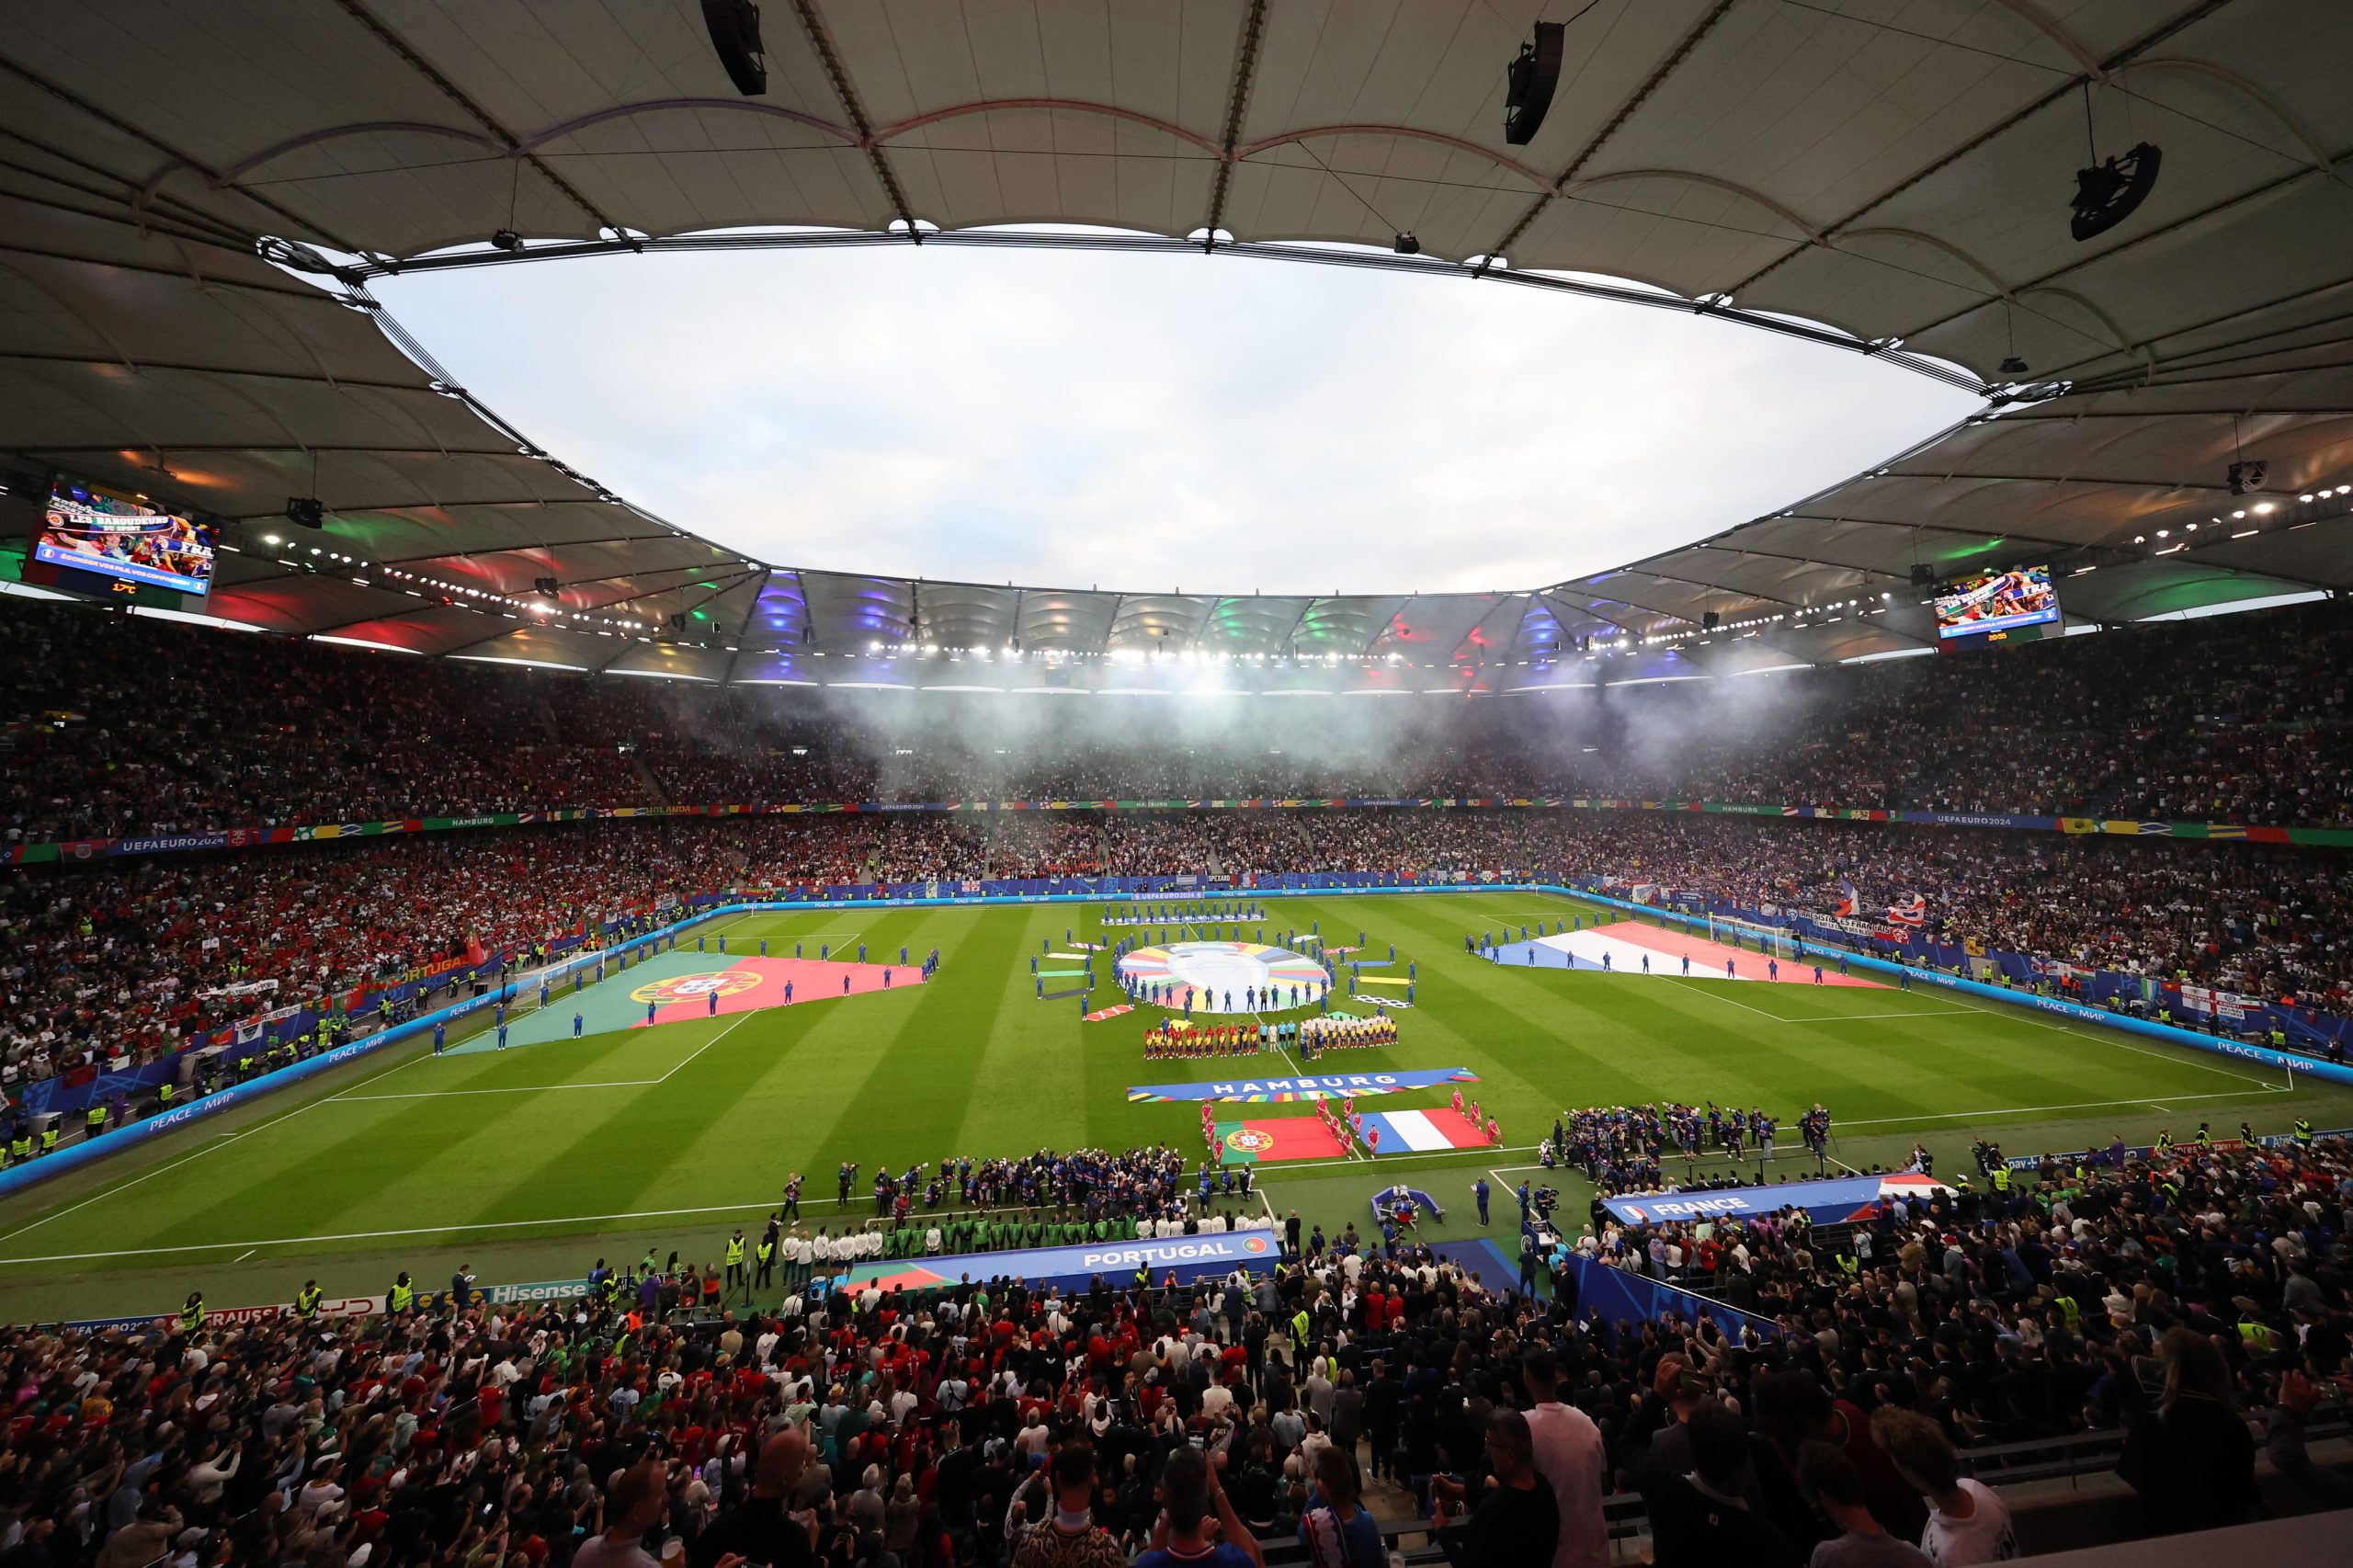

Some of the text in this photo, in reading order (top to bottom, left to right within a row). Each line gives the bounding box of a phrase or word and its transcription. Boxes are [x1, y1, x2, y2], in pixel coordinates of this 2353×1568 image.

[69, 515, 169, 526] LES BAROUDEURS
[1722, 805, 1758, 813] HAMBURG
[452, 817, 494, 826] HAMBURG
[1208, 874, 1231, 882] SPEXARD
[1806, 946, 1824, 956] PEACE
[1937, 976, 1956, 986] МИР
[449, 1002, 471, 1017] PEACE
[2036, 999, 2069, 1014] PEACE
[2079, 1009, 2105, 1021] МИР
[328, 1045, 358, 1062] PEACE
[365, 1035, 386, 1050] МИР
[2217, 1041, 2263, 1060] PEACE
[2277, 1055, 2314, 1071] МИР
[1212, 1074, 1397, 1095] HAMBURG
[150, 1108, 192, 1131] PEACE
[204, 1092, 234, 1110] МИР
[1651, 1197, 1750, 1216] FRANCE
[1084, 1242, 1234, 1267] PORTUGAL
[493, 1283, 586, 1303] Hisense
